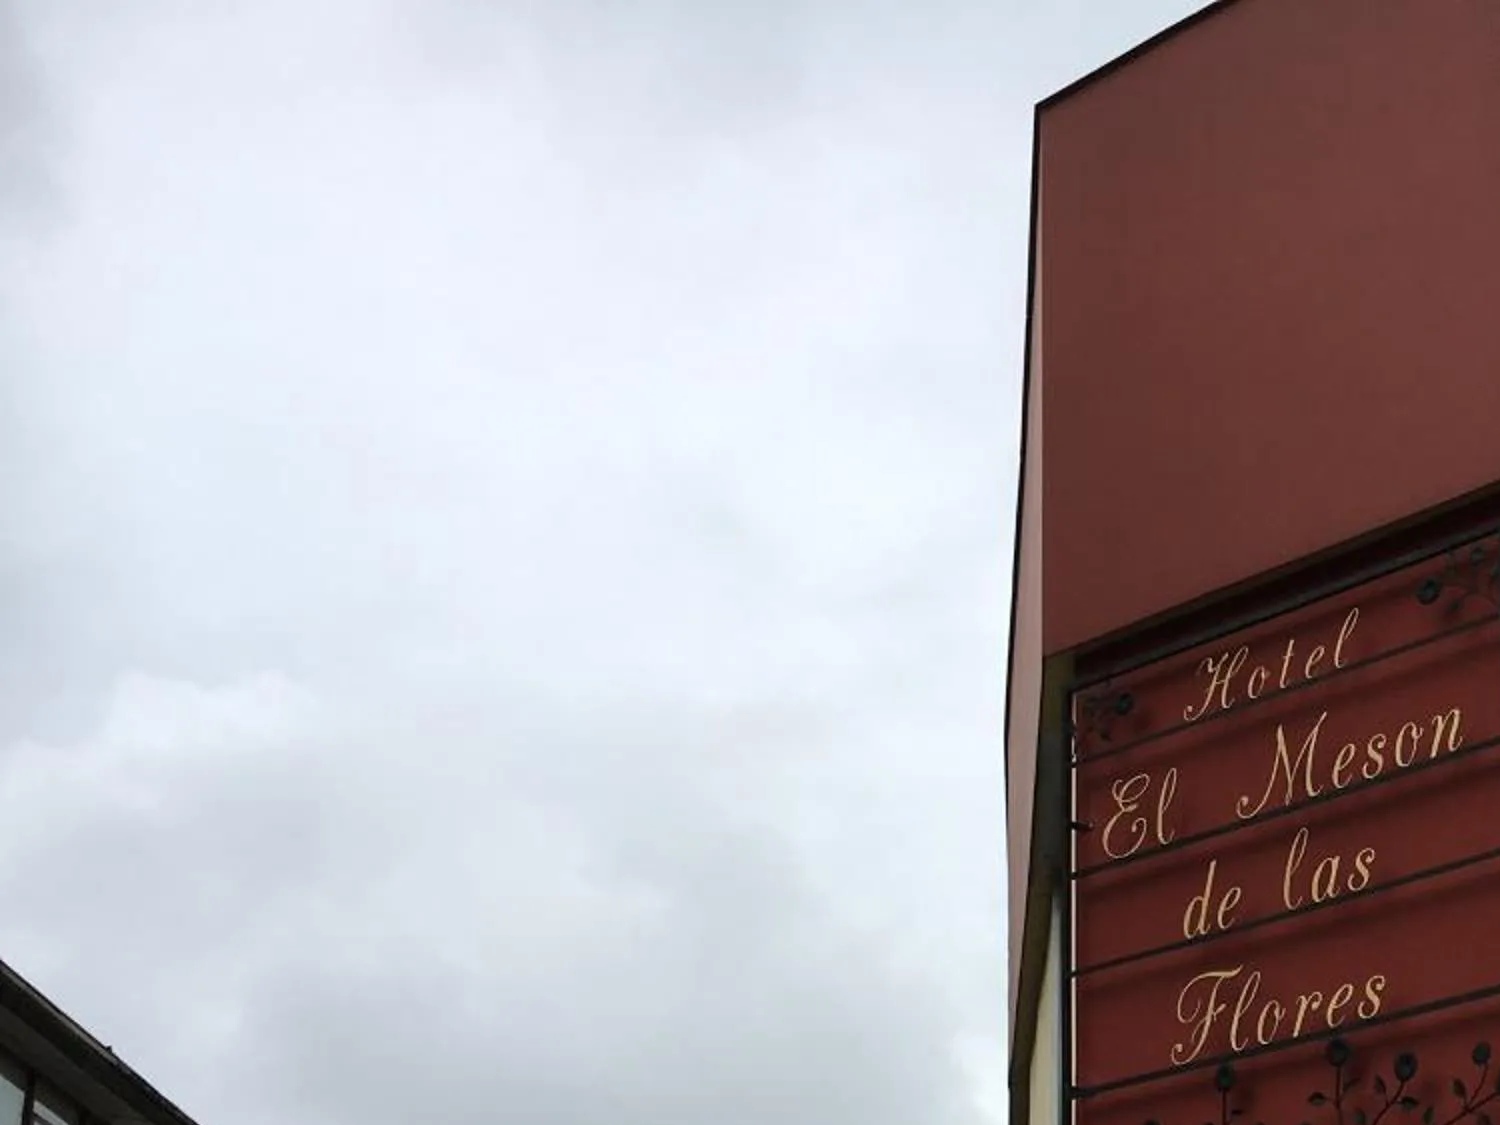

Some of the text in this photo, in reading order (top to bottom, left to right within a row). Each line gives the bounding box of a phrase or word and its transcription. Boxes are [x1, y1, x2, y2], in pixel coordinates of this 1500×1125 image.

[1183, 606, 1359, 722] Hotel
[1101, 705, 1463, 860] El Meson
[1183, 827, 1377, 940] de las
[1171, 964, 1387, 1066] Flores
